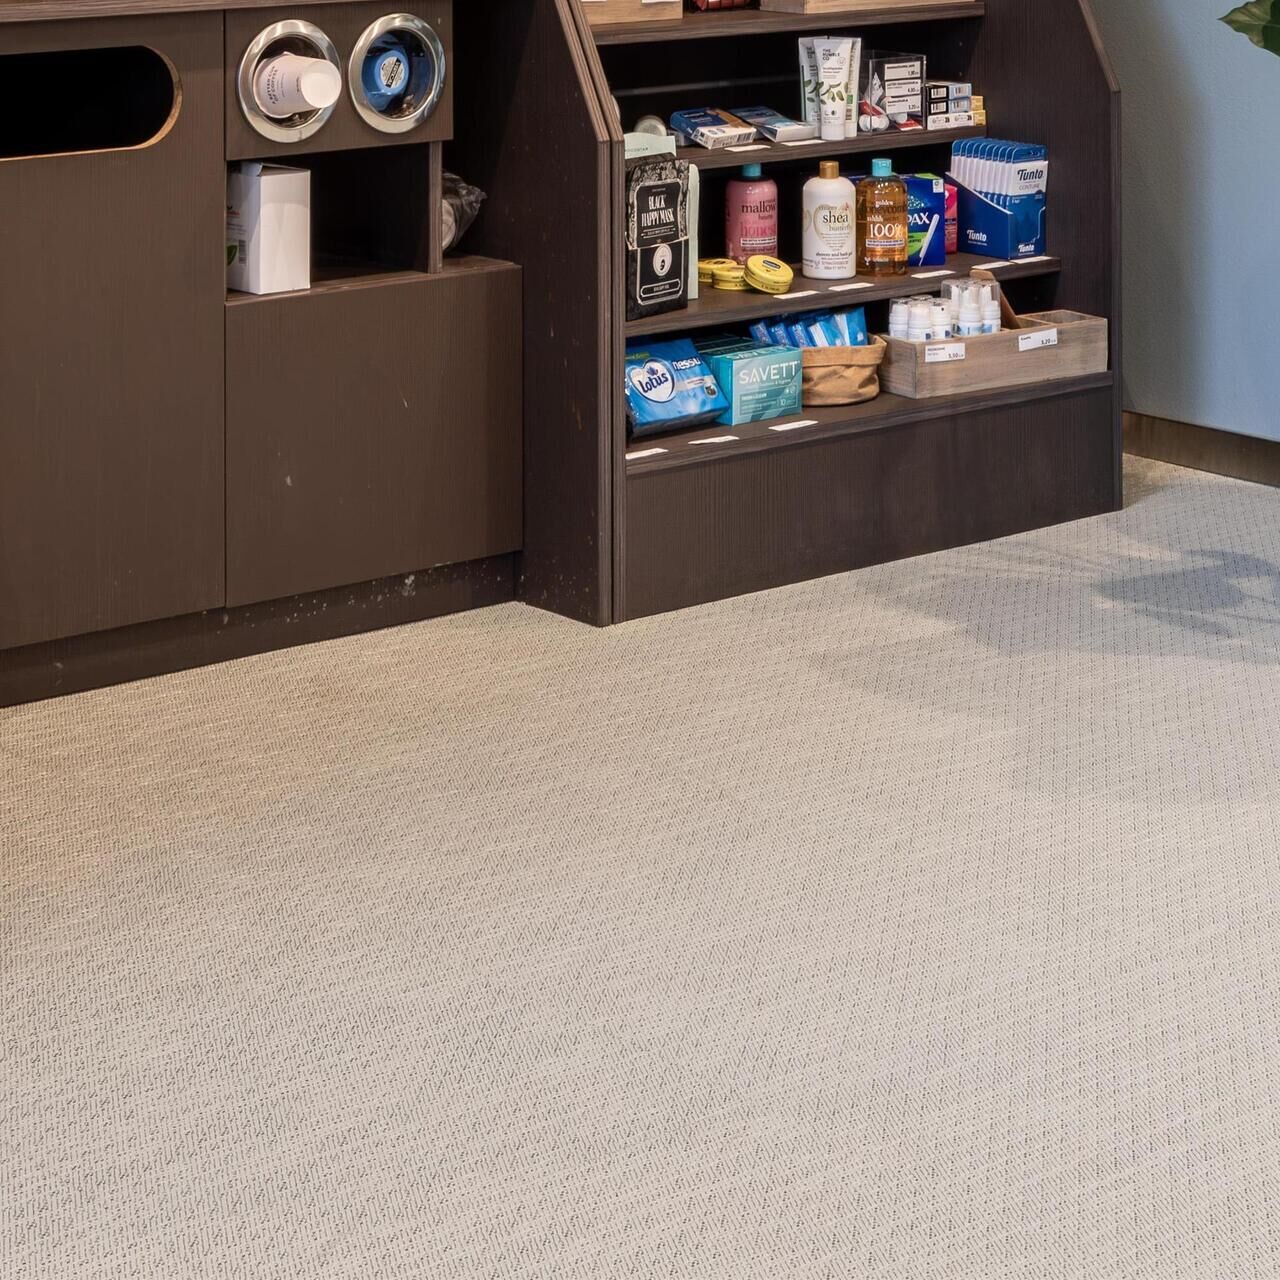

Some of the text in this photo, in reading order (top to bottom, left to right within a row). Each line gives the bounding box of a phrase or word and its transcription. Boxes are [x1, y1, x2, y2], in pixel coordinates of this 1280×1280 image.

[1017, 168, 1044, 181] Tunto
[648, 194, 666, 210] BLACK
[741, 200, 776, 213] mallow
[641, 208, 675, 228] HAPPY MASK
[822, 210, 849, 224] shea
[966, 229, 988, 242] Tunto
[1018, 244, 1035, 253] Tunto
[739, 360, 798, 385] SAVETT
[638, 372, 669, 394] lotus
